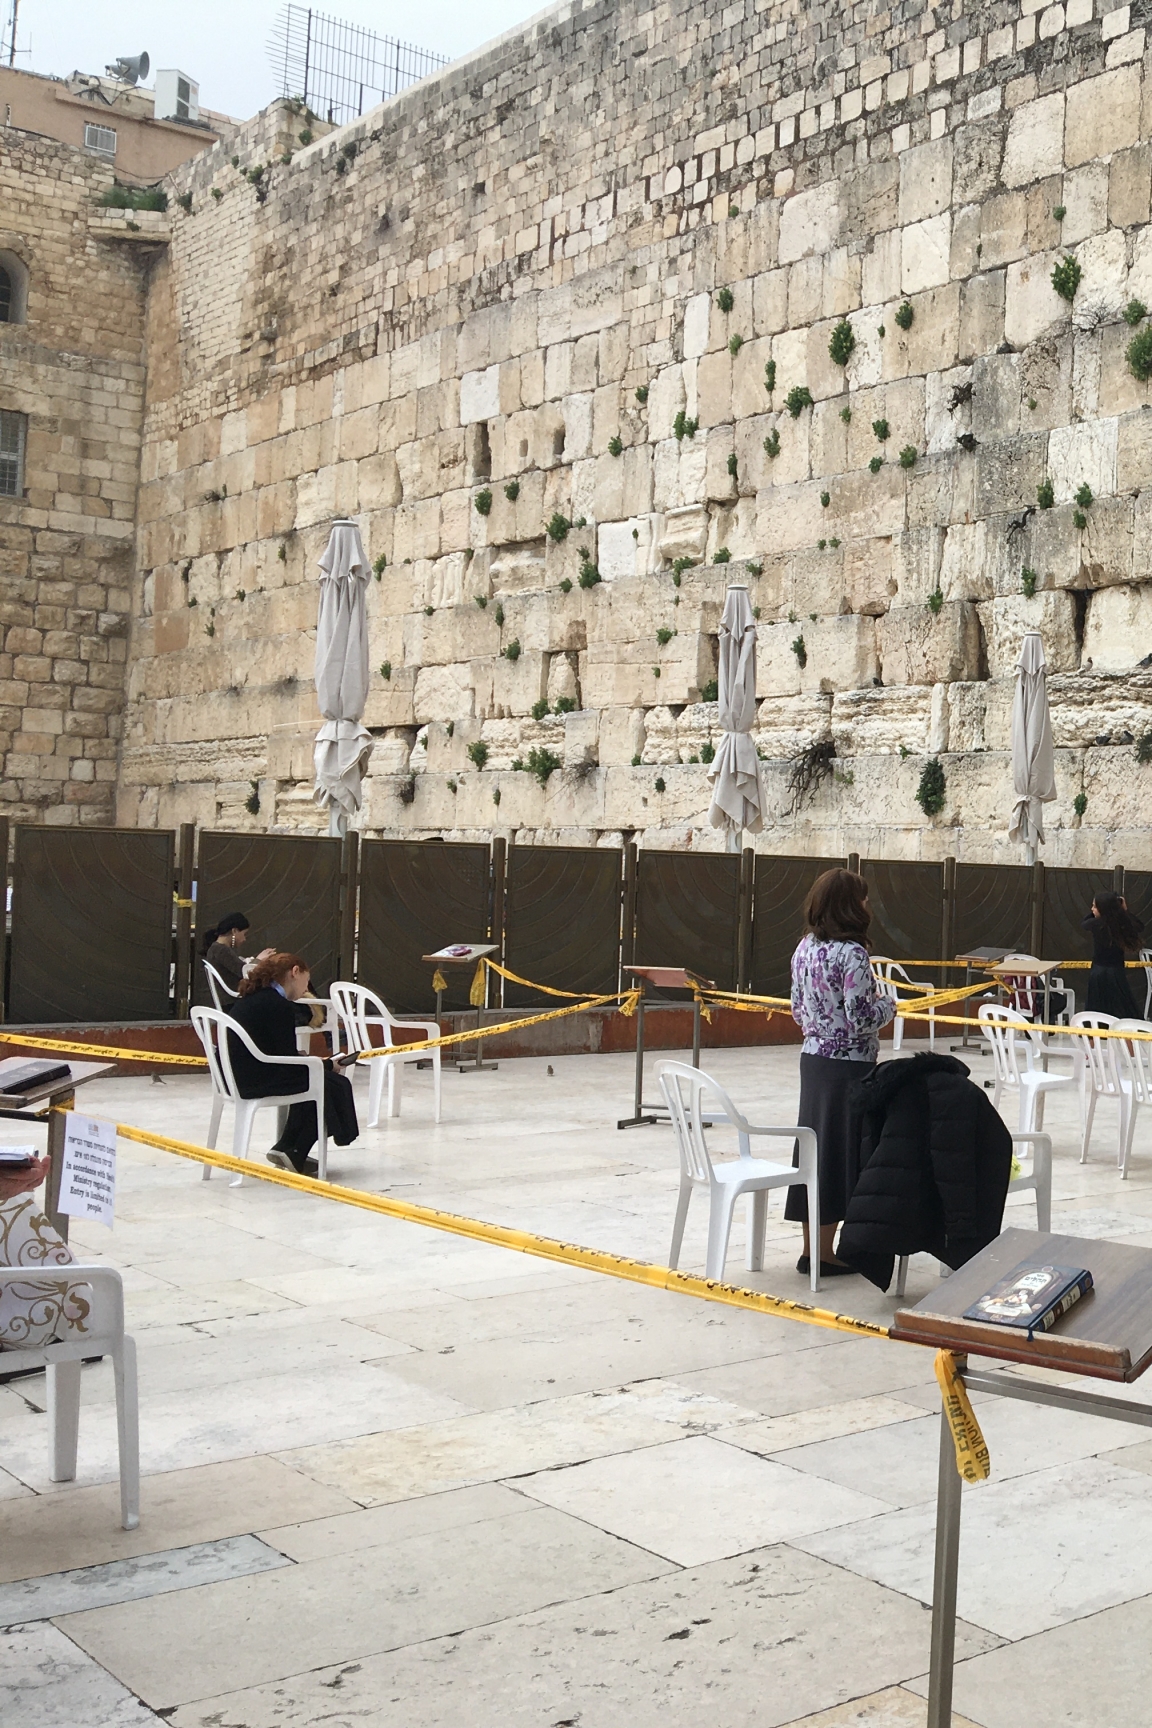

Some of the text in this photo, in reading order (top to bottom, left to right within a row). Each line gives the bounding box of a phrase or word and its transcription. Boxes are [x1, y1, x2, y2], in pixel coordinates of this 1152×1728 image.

[66, 1160, 71, 1169] In
[73, 1163, 96, 1176] accordance
[97, 1169, 106, 1179] with
[73, 1174, 92, 1187] Ministry
[70, 1186, 85, 1198] Entry
[90, 1191, 104, 1202] limited
[87, 1203, 102, 1213] people.
